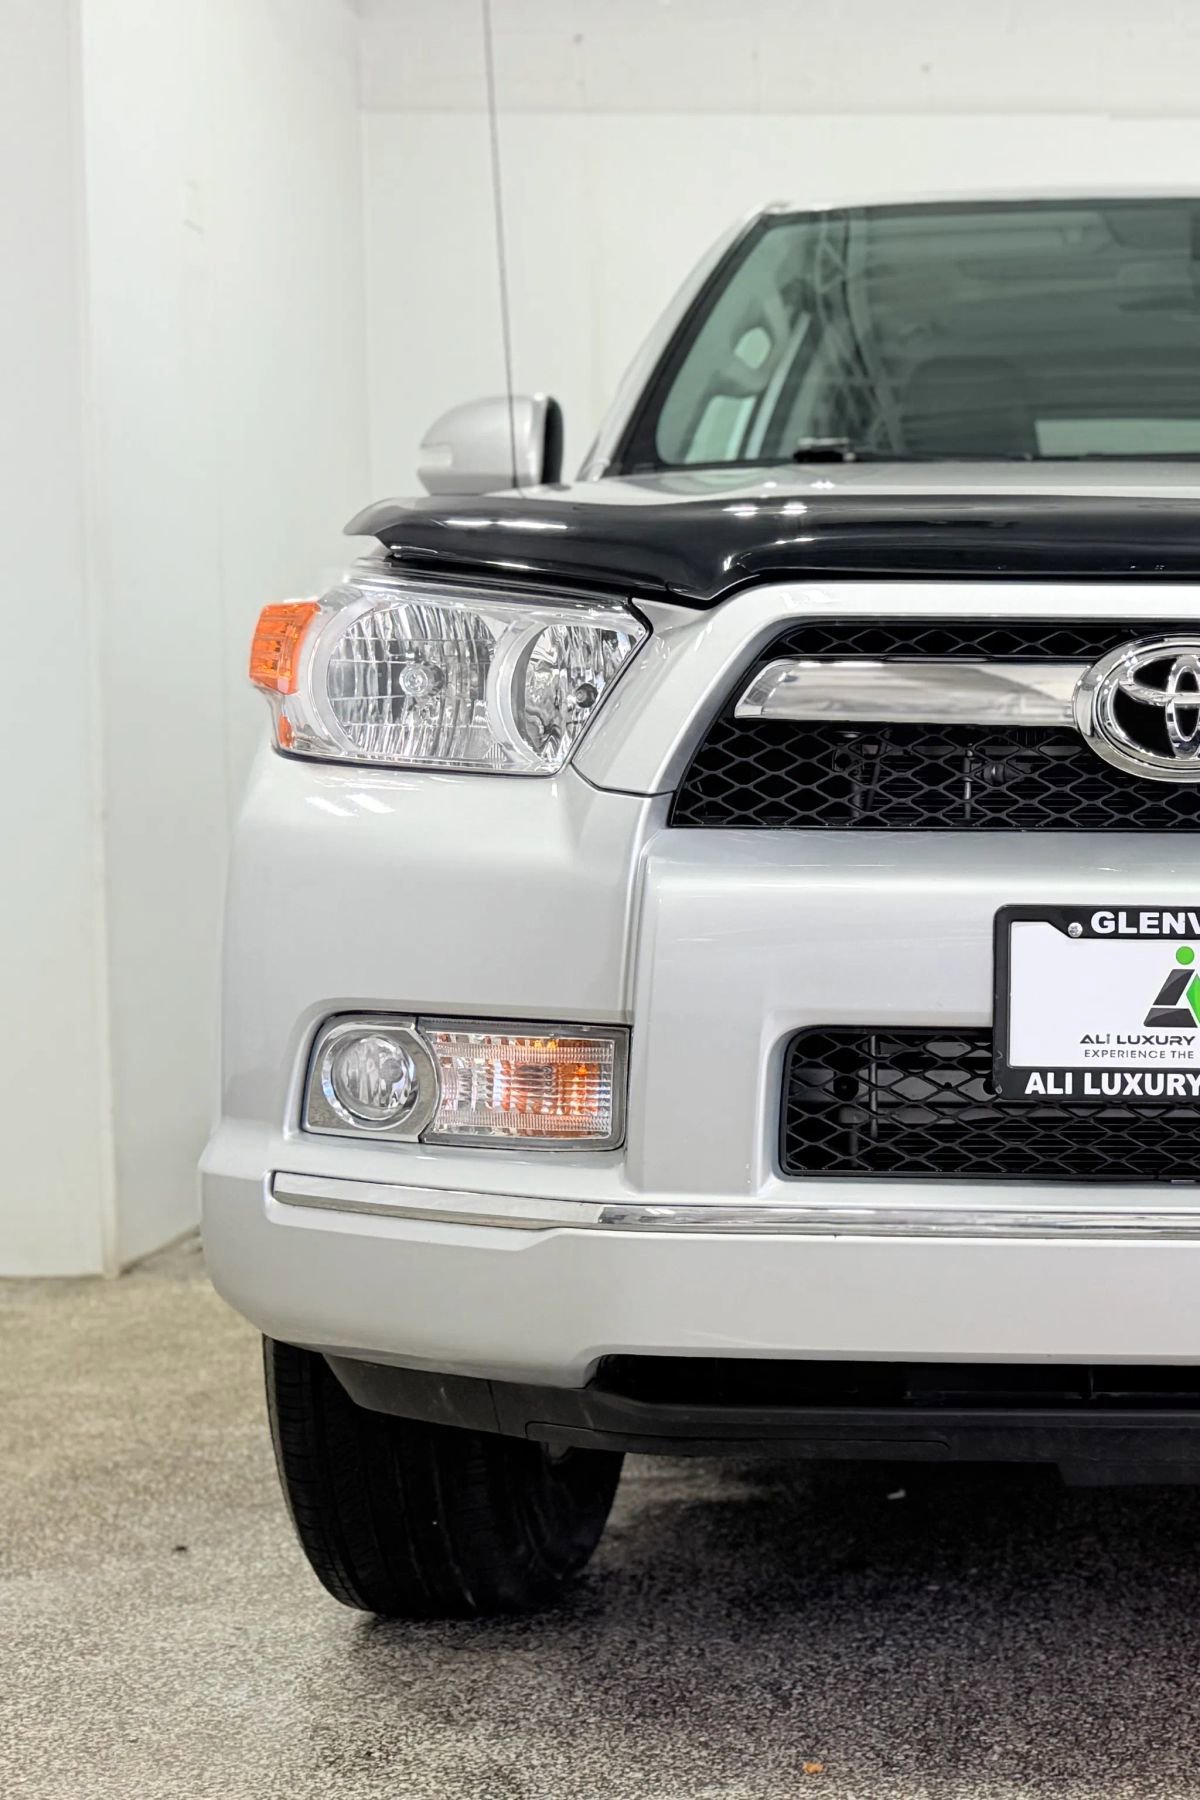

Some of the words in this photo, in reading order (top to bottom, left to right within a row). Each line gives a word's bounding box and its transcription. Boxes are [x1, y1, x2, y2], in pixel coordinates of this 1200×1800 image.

[1116, 1034, 1196, 1046] LUXURY
[1083, 1048, 1166, 1059] EXPERIENCE
[1170, 1050, 1195, 1060] THE
[1024, 1071, 1073, 1095] ALI
